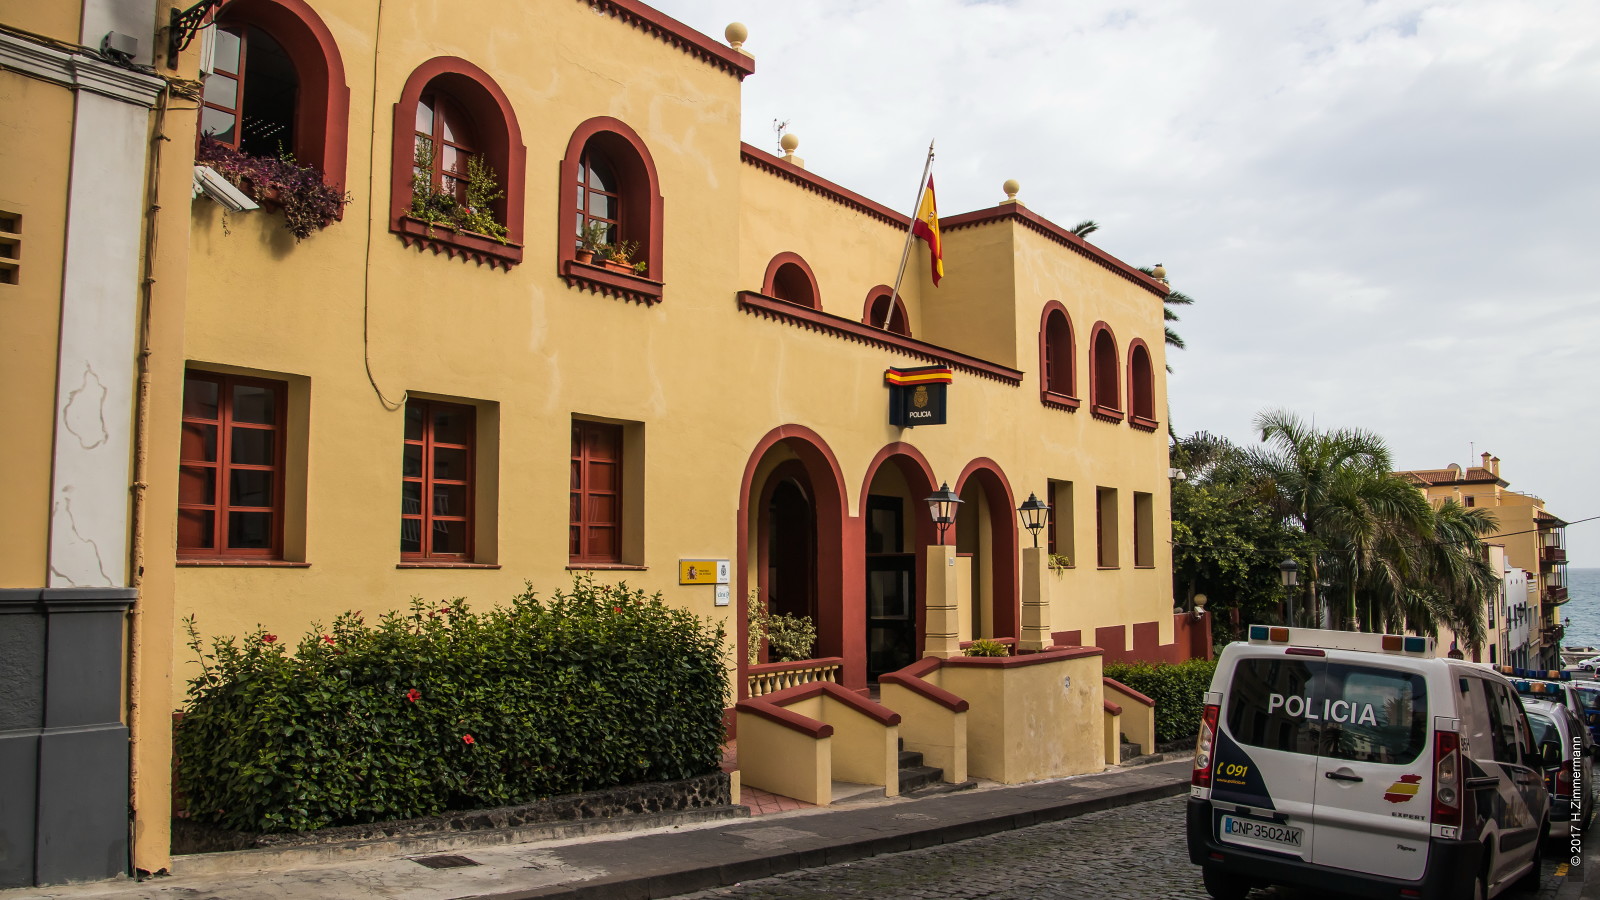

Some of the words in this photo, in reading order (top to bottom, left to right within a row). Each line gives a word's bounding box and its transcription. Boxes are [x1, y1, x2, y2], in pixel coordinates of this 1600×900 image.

[1268, 693, 1377, 726] POLICIA
[1226, 763, 1248, 777] 091
[1391, 812, 1425, 820] EXPERT
[1231, 820, 1253, 835] CNP
